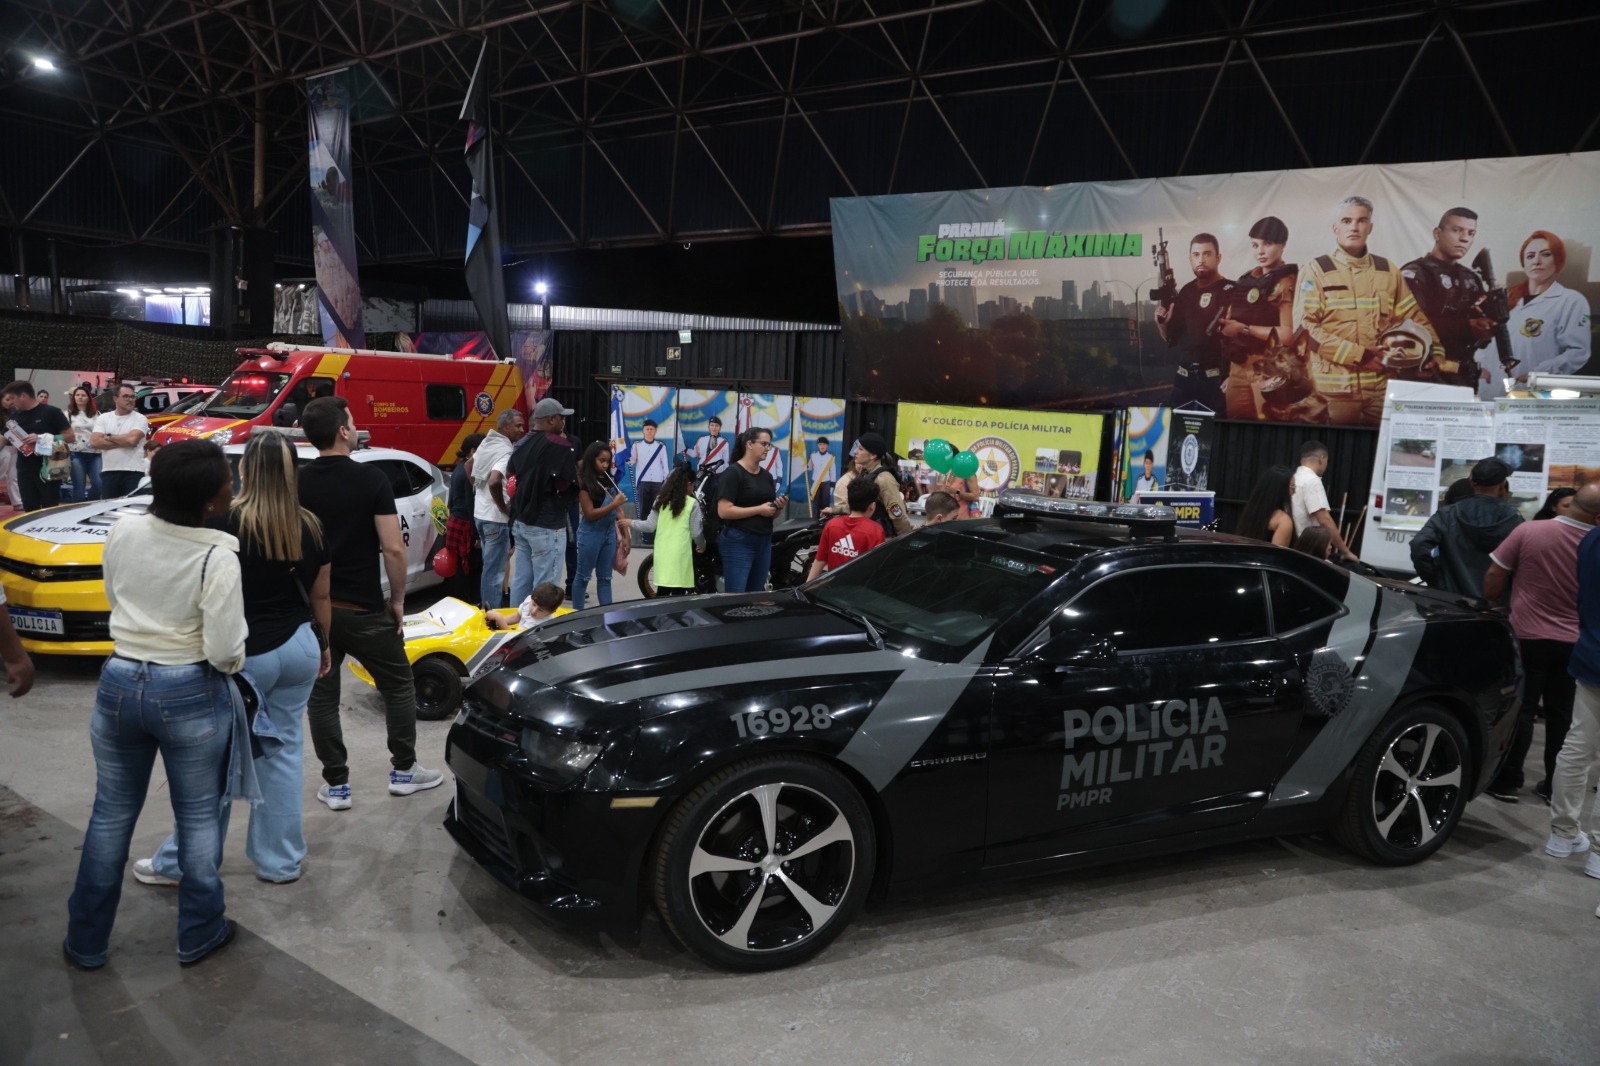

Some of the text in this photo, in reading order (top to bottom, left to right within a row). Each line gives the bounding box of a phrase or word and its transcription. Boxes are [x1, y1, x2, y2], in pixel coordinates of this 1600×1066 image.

[938, 218, 1005, 238] PARANÁ
[916, 230, 1143, 264] FORÇA MÁXIMA
[935, 278, 969, 287] PROTEGE
[939, 268, 1038, 280] SEGURANÇA PÚBLICA QUE
[933, 416, 974, 427] COLÉGIO
[975, 420, 989, 428] DA
[991, 421, 1030, 431] POLÍCIA
[1031, 424, 1072, 434] MILITAR
[1175, 506, 1201, 519] MPR
[831, 545, 859, 558] adidas
[11, 616, 57, 632] POLICIA
[730, 703, 832, 738] 16928
[1063, 696, 1229, 749] POLÍCIA
[910, 752, 987, 768] CAMARO
[1060, 734, 1227, 790] MILITAR
[1057, 787, 1113, 811] PMPR
